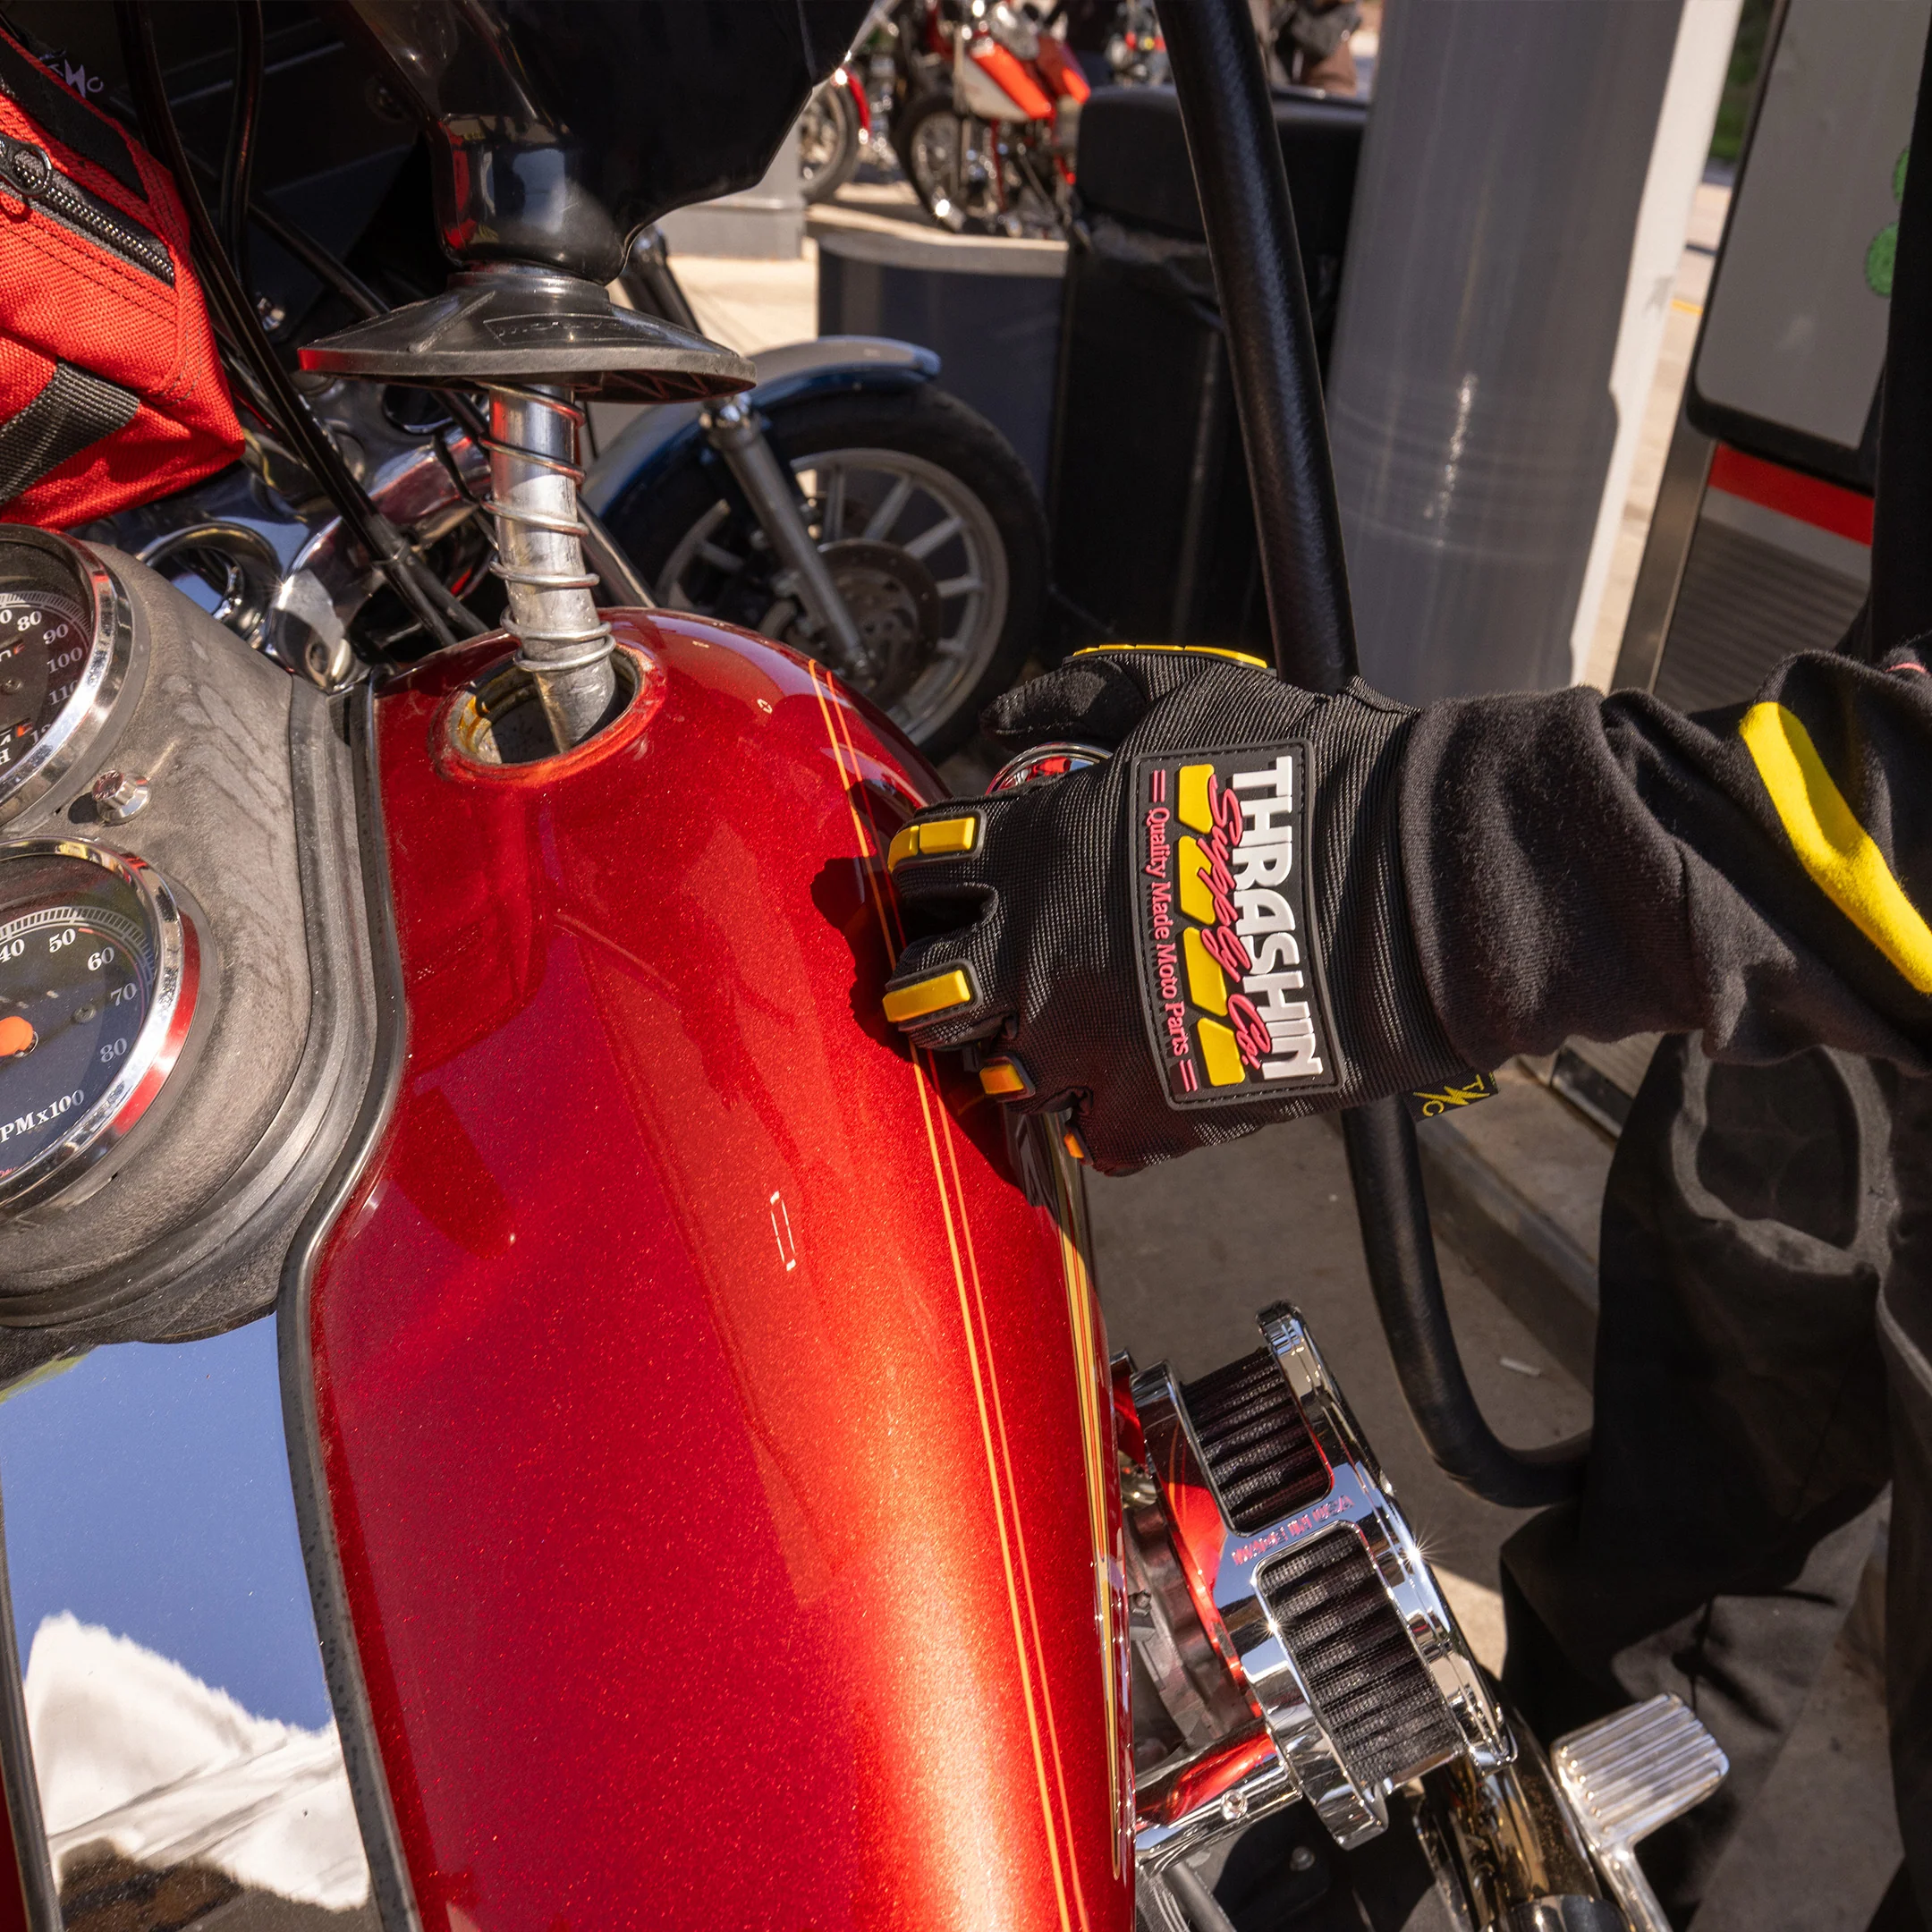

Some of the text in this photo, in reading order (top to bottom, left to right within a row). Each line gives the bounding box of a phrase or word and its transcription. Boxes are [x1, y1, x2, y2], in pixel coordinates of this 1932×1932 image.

[17, 610, 42, 631] 80
[43, 623, 69, 645] 90
[47, 647, 83, 674] 100
[1196, 774, 1251, 983] Supply
[1232, 755, 1324, 1080] THRASHIN
[49, 928, 76, 953] 50
[1145, 806, 1190, 1057] Quality Made Moto Parts
[0, 938, 25, 963] 40
[88, 946, 114, 971] 60
[110, 982, 137, 1007] 70
[99, 1038, 128, 1063] 80
[0, 1089, 85, 1143] PMx100
